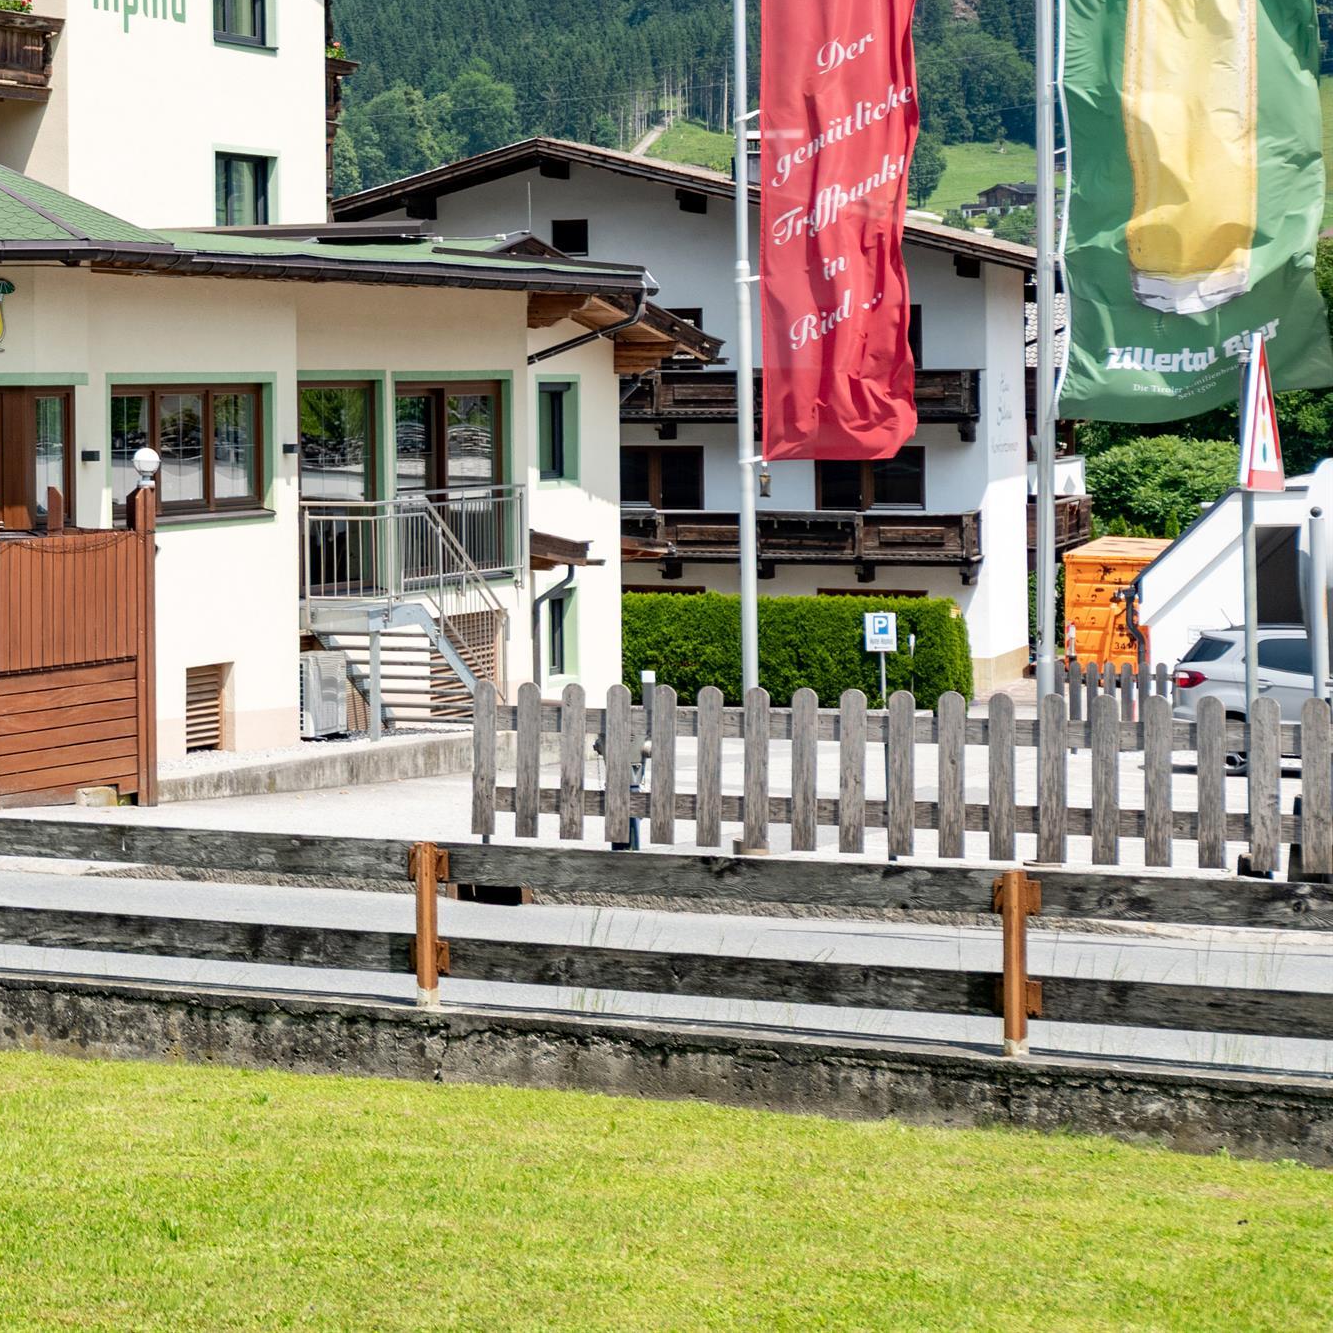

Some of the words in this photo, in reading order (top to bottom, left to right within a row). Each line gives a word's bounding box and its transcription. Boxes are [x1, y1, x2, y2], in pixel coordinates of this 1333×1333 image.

[816, 32, 876, 75] Der
[771, 83, 914, 188] gemütliche
[822, 254, 848, 281] in
[789, 289, 854, 351] Ried
[1105, 346, 1220, 373] Zillertal
[1133, 383, 1149, 393] Die
[1151, 383, 1183, 394] Tiroler
[874, 617, 887, 634] P
